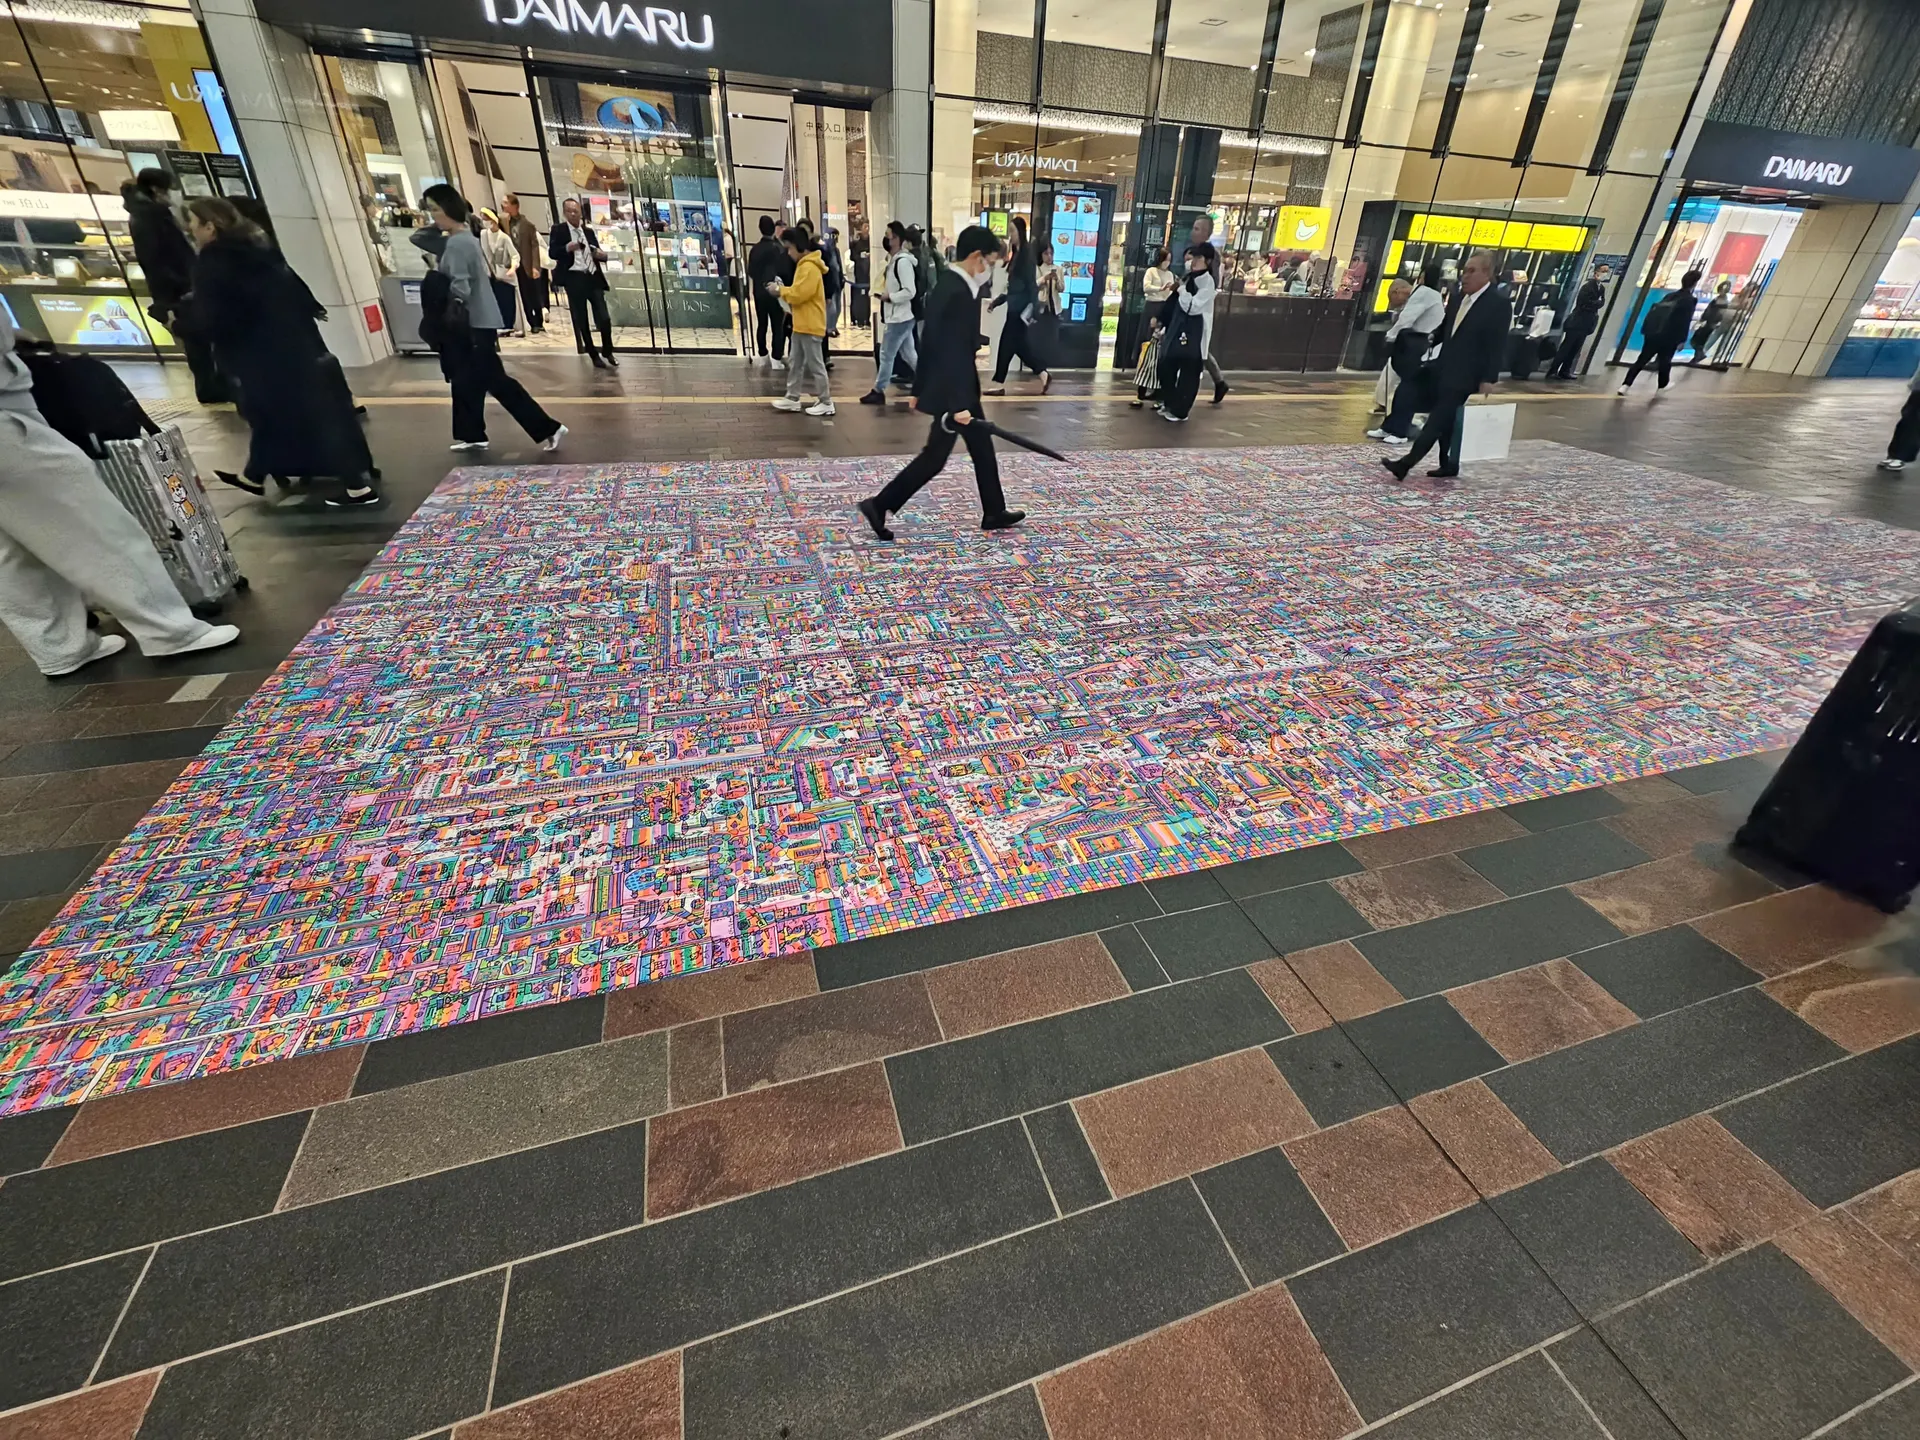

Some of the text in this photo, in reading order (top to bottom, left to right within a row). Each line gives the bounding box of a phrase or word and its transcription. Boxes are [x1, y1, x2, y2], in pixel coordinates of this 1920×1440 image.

[484, 0, 714, 49] DAIMARU
[805, 121, 841, 133] 中央入口
[1762, 155, 1854, 187] DAIMARU
